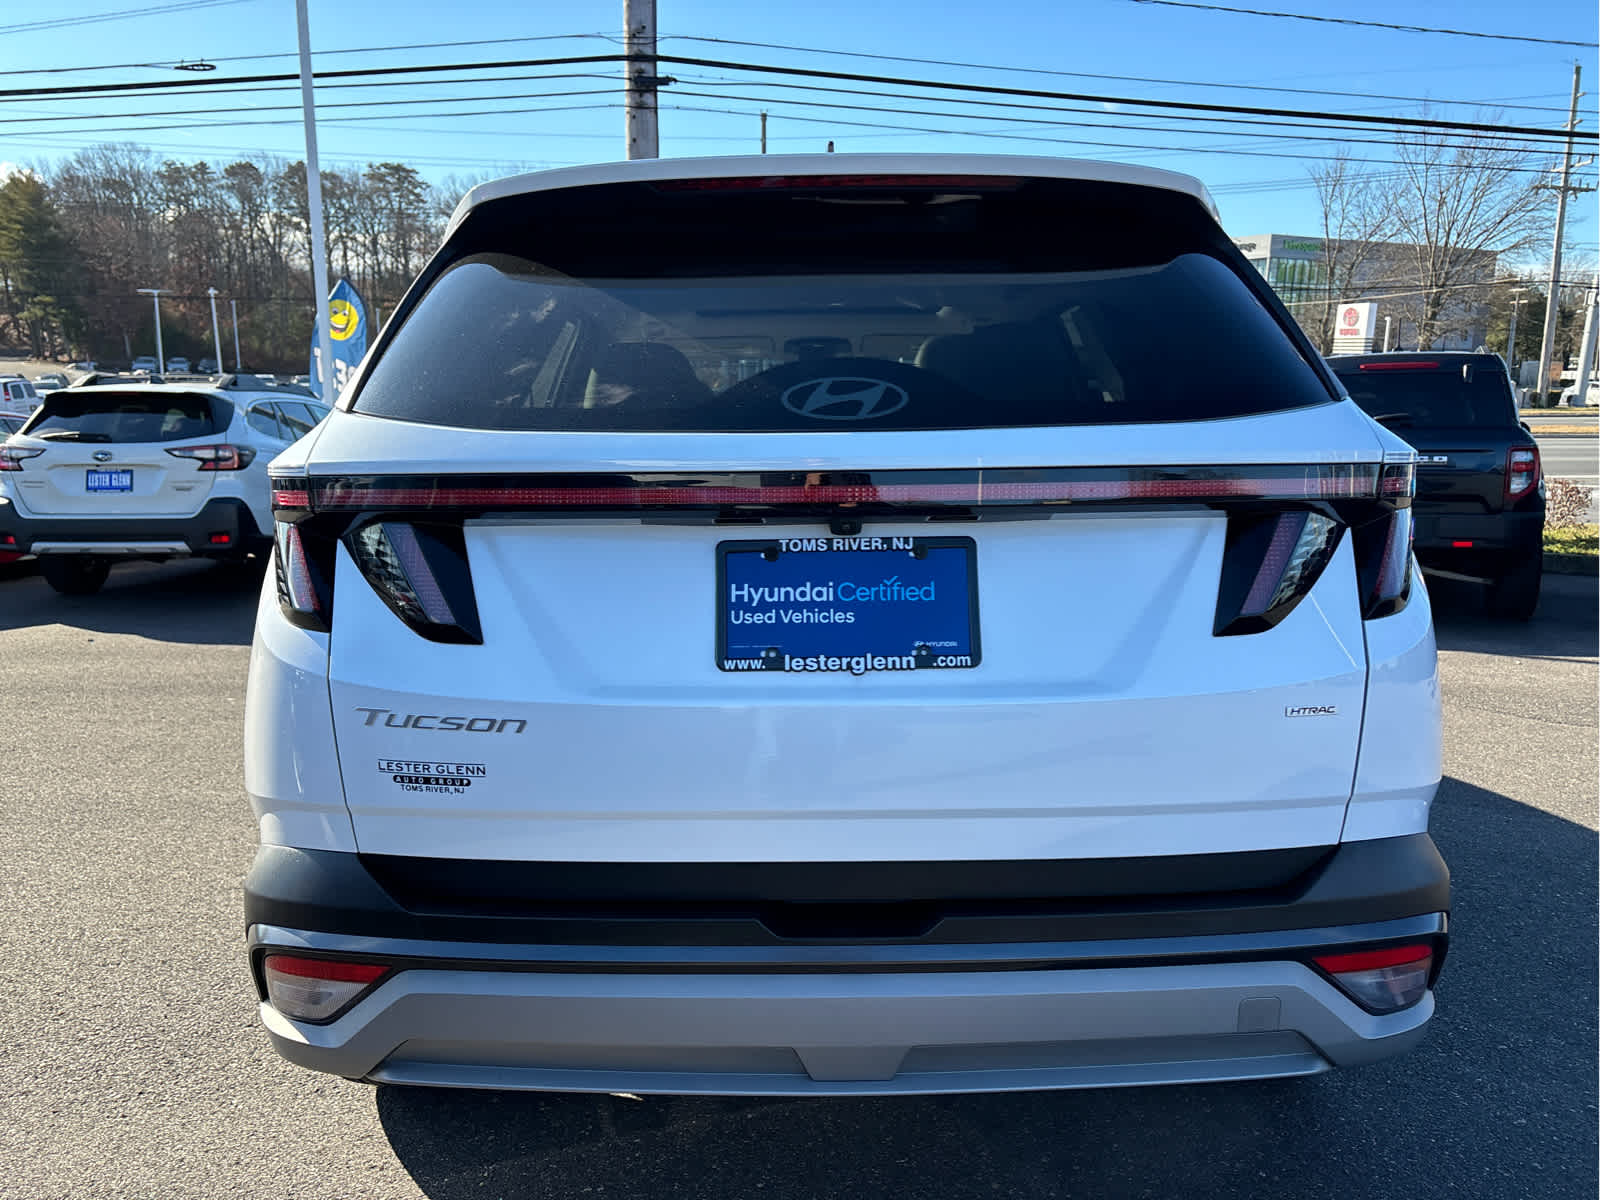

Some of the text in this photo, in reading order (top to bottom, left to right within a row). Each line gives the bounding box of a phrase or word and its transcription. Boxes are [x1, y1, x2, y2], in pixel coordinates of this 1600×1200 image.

[779, 537, 914, 552] TOMS RIVER, NJ
[730, 576, 935, 606] Hyundai Certified
[730, 608, 855, 624] Used Vehicles
[724, 653, 971, 674] www. lesterglenn .com
[1289, 705, 1336, 715] HTRAC
[378, 761, 486, 776] LESTER GLENN
[395, 775, 468, 787] AUTO GROUP
[401, 784, 424, 792] TOMS
